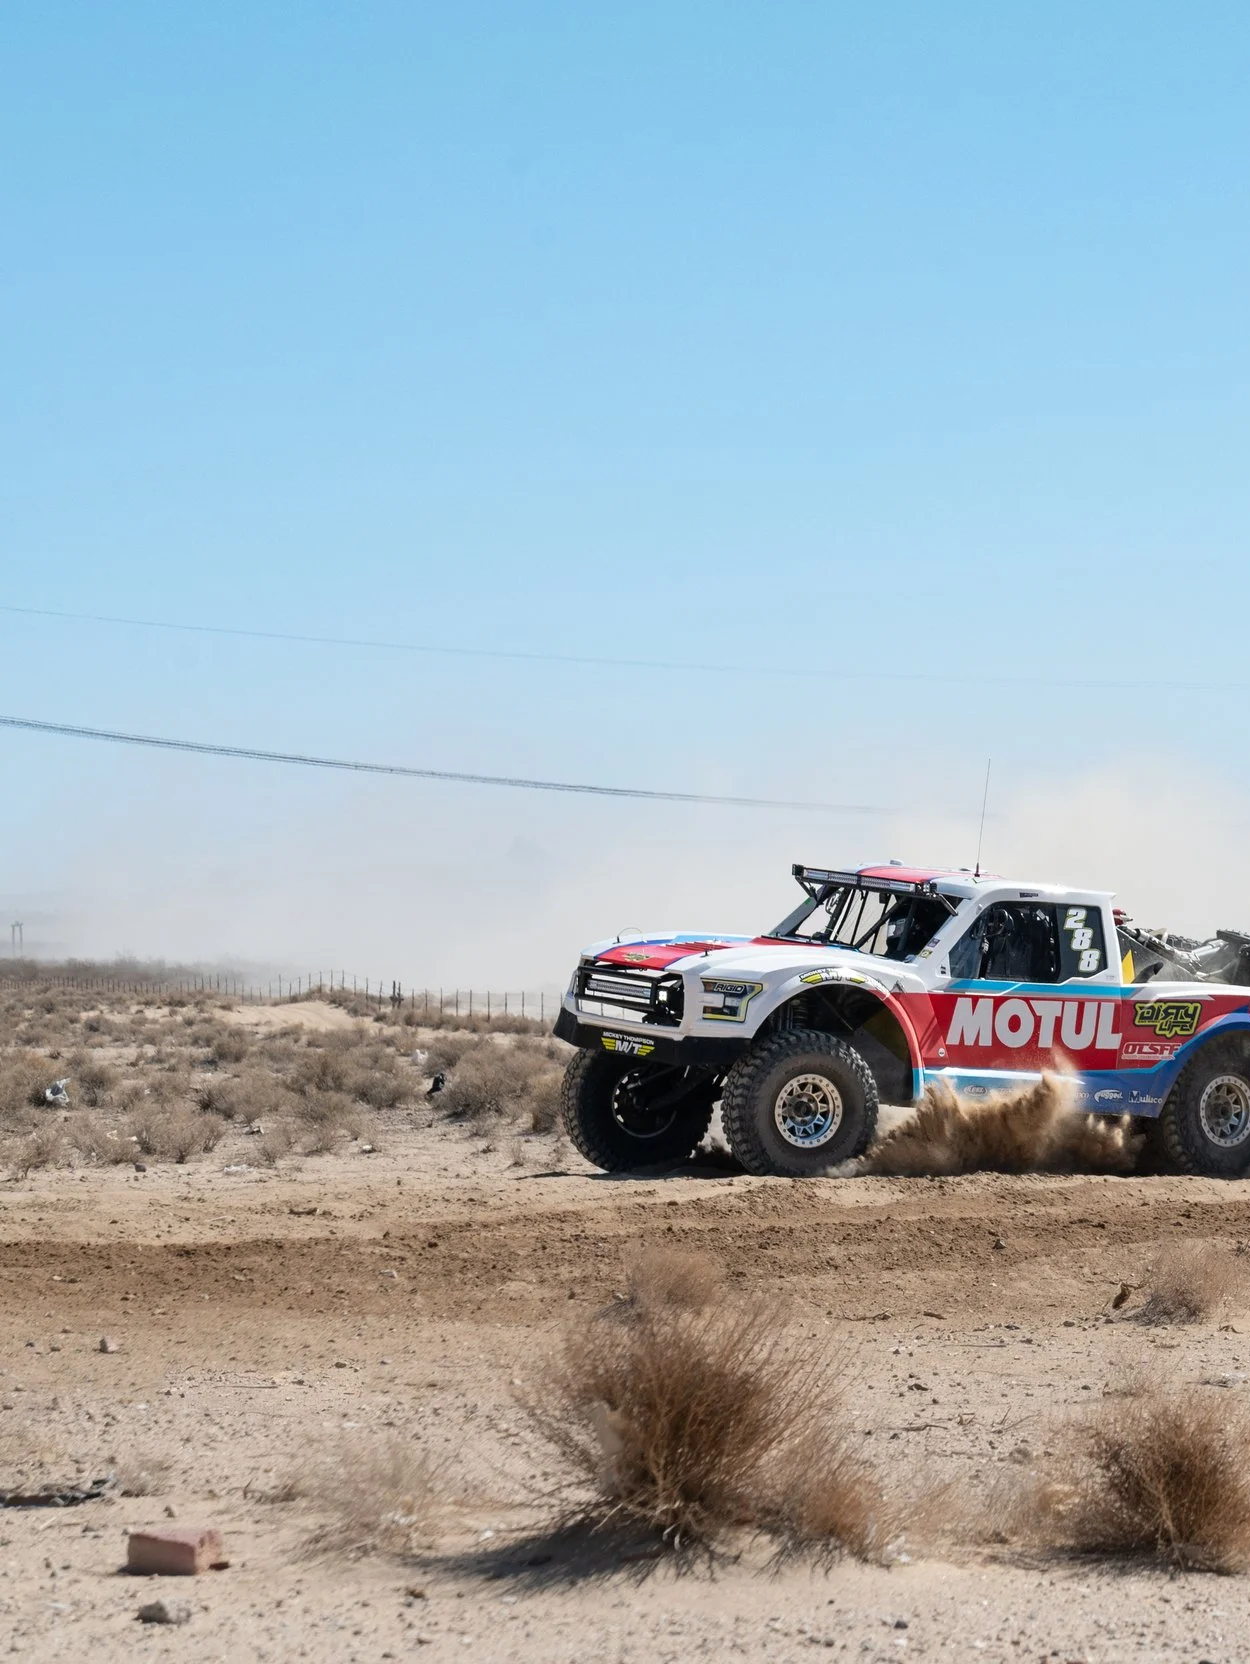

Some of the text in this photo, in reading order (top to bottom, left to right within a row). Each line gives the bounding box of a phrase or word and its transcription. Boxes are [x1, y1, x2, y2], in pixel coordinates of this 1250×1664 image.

[1064, 907, 1101, 973] 288
[714, 983, 744, 993] RIGID
[1137, 1004, 1200, 1022] DIRTY
[946, 997, 1122, 1050] MOTUL
[1158, 1020, 1194, 1033] LIFE
[602, 1031, 654, 1045] MICKEY THOMPSON
[615, 1040, 642, 1054] M/T
